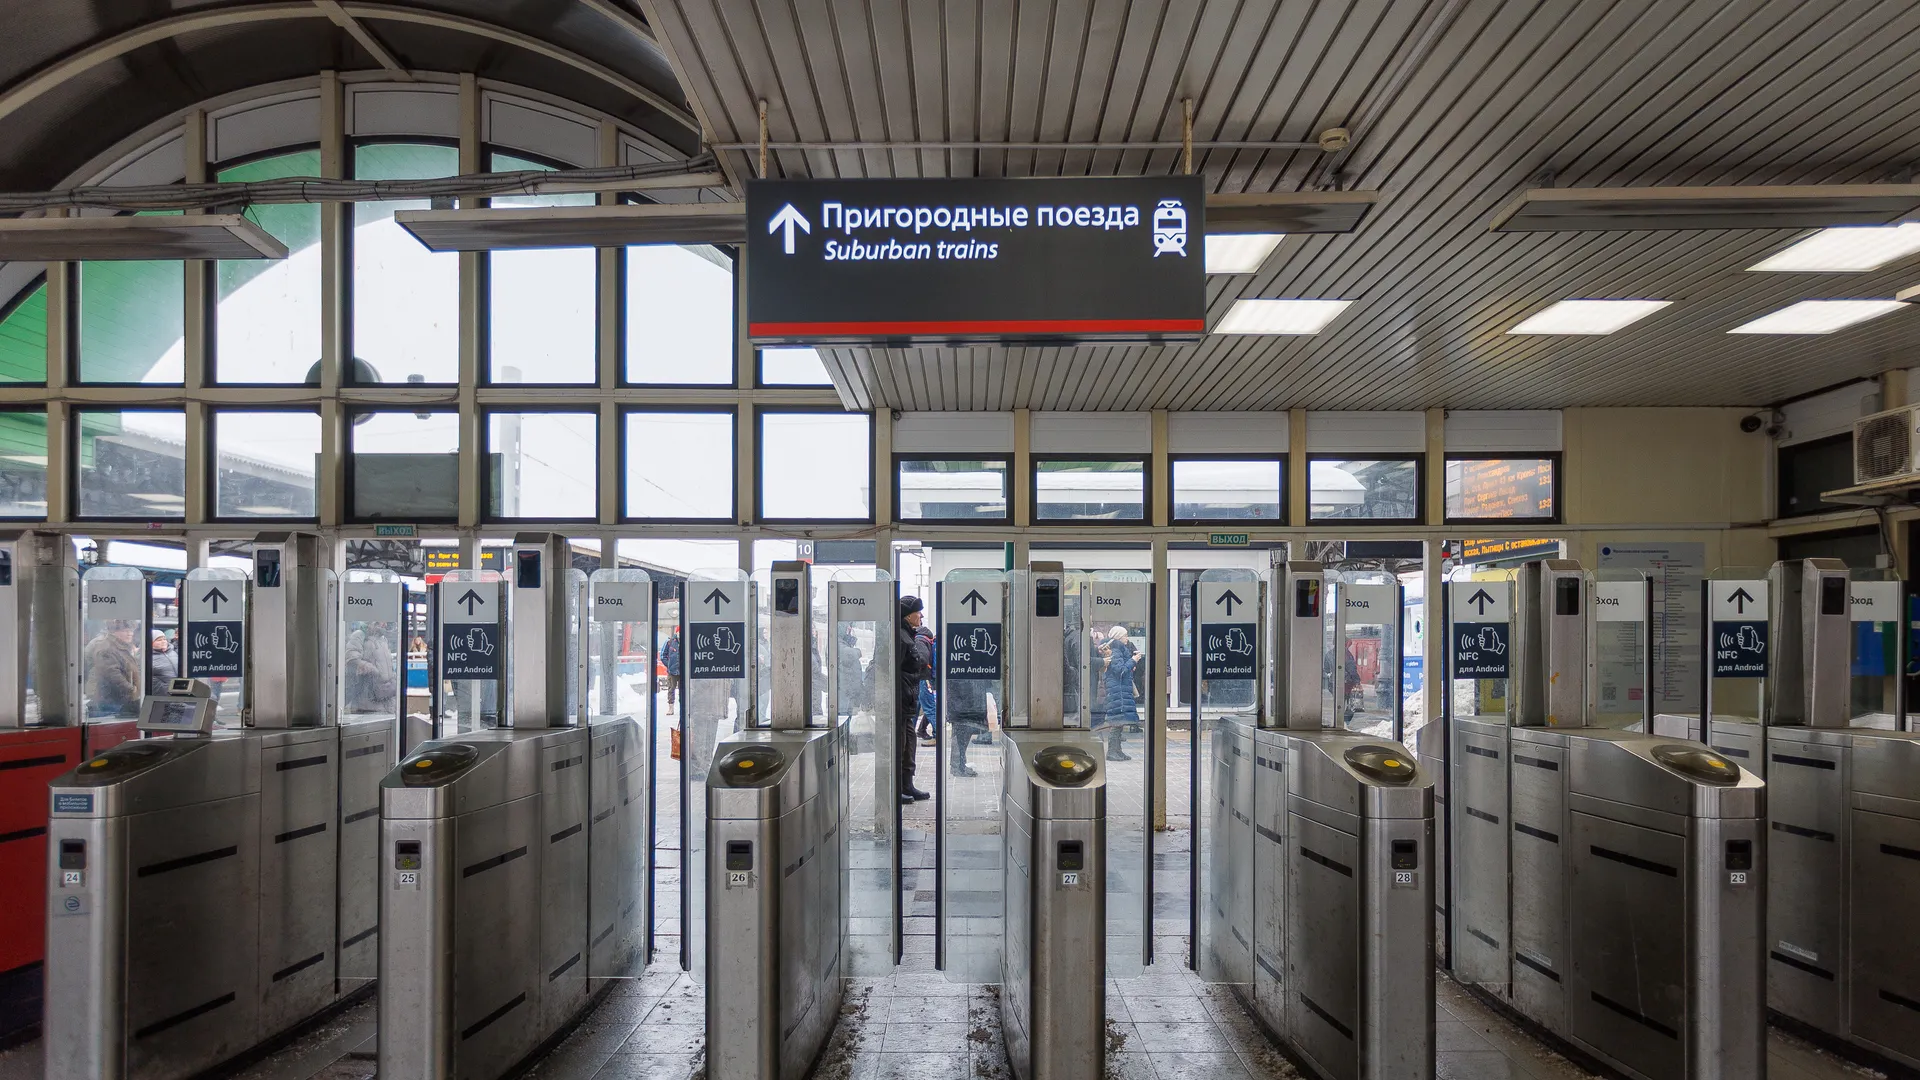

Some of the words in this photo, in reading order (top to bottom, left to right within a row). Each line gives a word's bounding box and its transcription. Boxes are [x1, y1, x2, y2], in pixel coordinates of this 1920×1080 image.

[822, 201, 1029, 235] Пригородные
[1037, 206, 1139, 231] поезда
[824, 239, 931, 261] Suburban
[937, 238, 999, 260] trains
[379, 526, 412, 535] ВЫХОД
[1212, 534, 1246, 545] ВЫХОД
[798, 544, 811, 555] 10
[91, 595, 117, 605] Вход
[348, 595, 373, 606] Вход
[598, 596, 623, 607] Вход
[840, 596, 866, 606] Вход
[1096, 596, 1122, 606] Вход
[1345, 598, 1370, 609] Вход
[193, 651, 213, 660] NFC
[448, 653, 468, 662] NFC
[695, 652, 715, 661] NFC
[951, 653, 971, 662] NFC
[1206, 653, 1226, 662] NFC
[1458, 652, 1478, 661] NFC
[1717, 651, 1737, 660] NFC
[193, 665, 208, 673] для
[209, 664, 238, 673] Android
[448, 667, 463, 675] для
[464, 666, 493, 675] Android
[695, 666, 710, 674] для
[711, 665, 740, 674] Android
[951, 667, 966, 675] для
[967, 666, 996, 675] Android
[1206, 667, 1221, 675] для
[1222, 666, 1252, 675] Android
[1458, 666, 1473, 674] для
[1474, 665, 1505, 674] Android
[1717, 665, 1732, 673] для
[1733, 664, 1764, 673] Android
[66, 873, 78, 882] 24
[402, 873, 414, 884] 25
[732, 873, 745, 882] 26
[1064, 875, 1076, 884] 27
[1397, 873, 1410, 883] 28
[1732, 873, 1745, 883] 29
